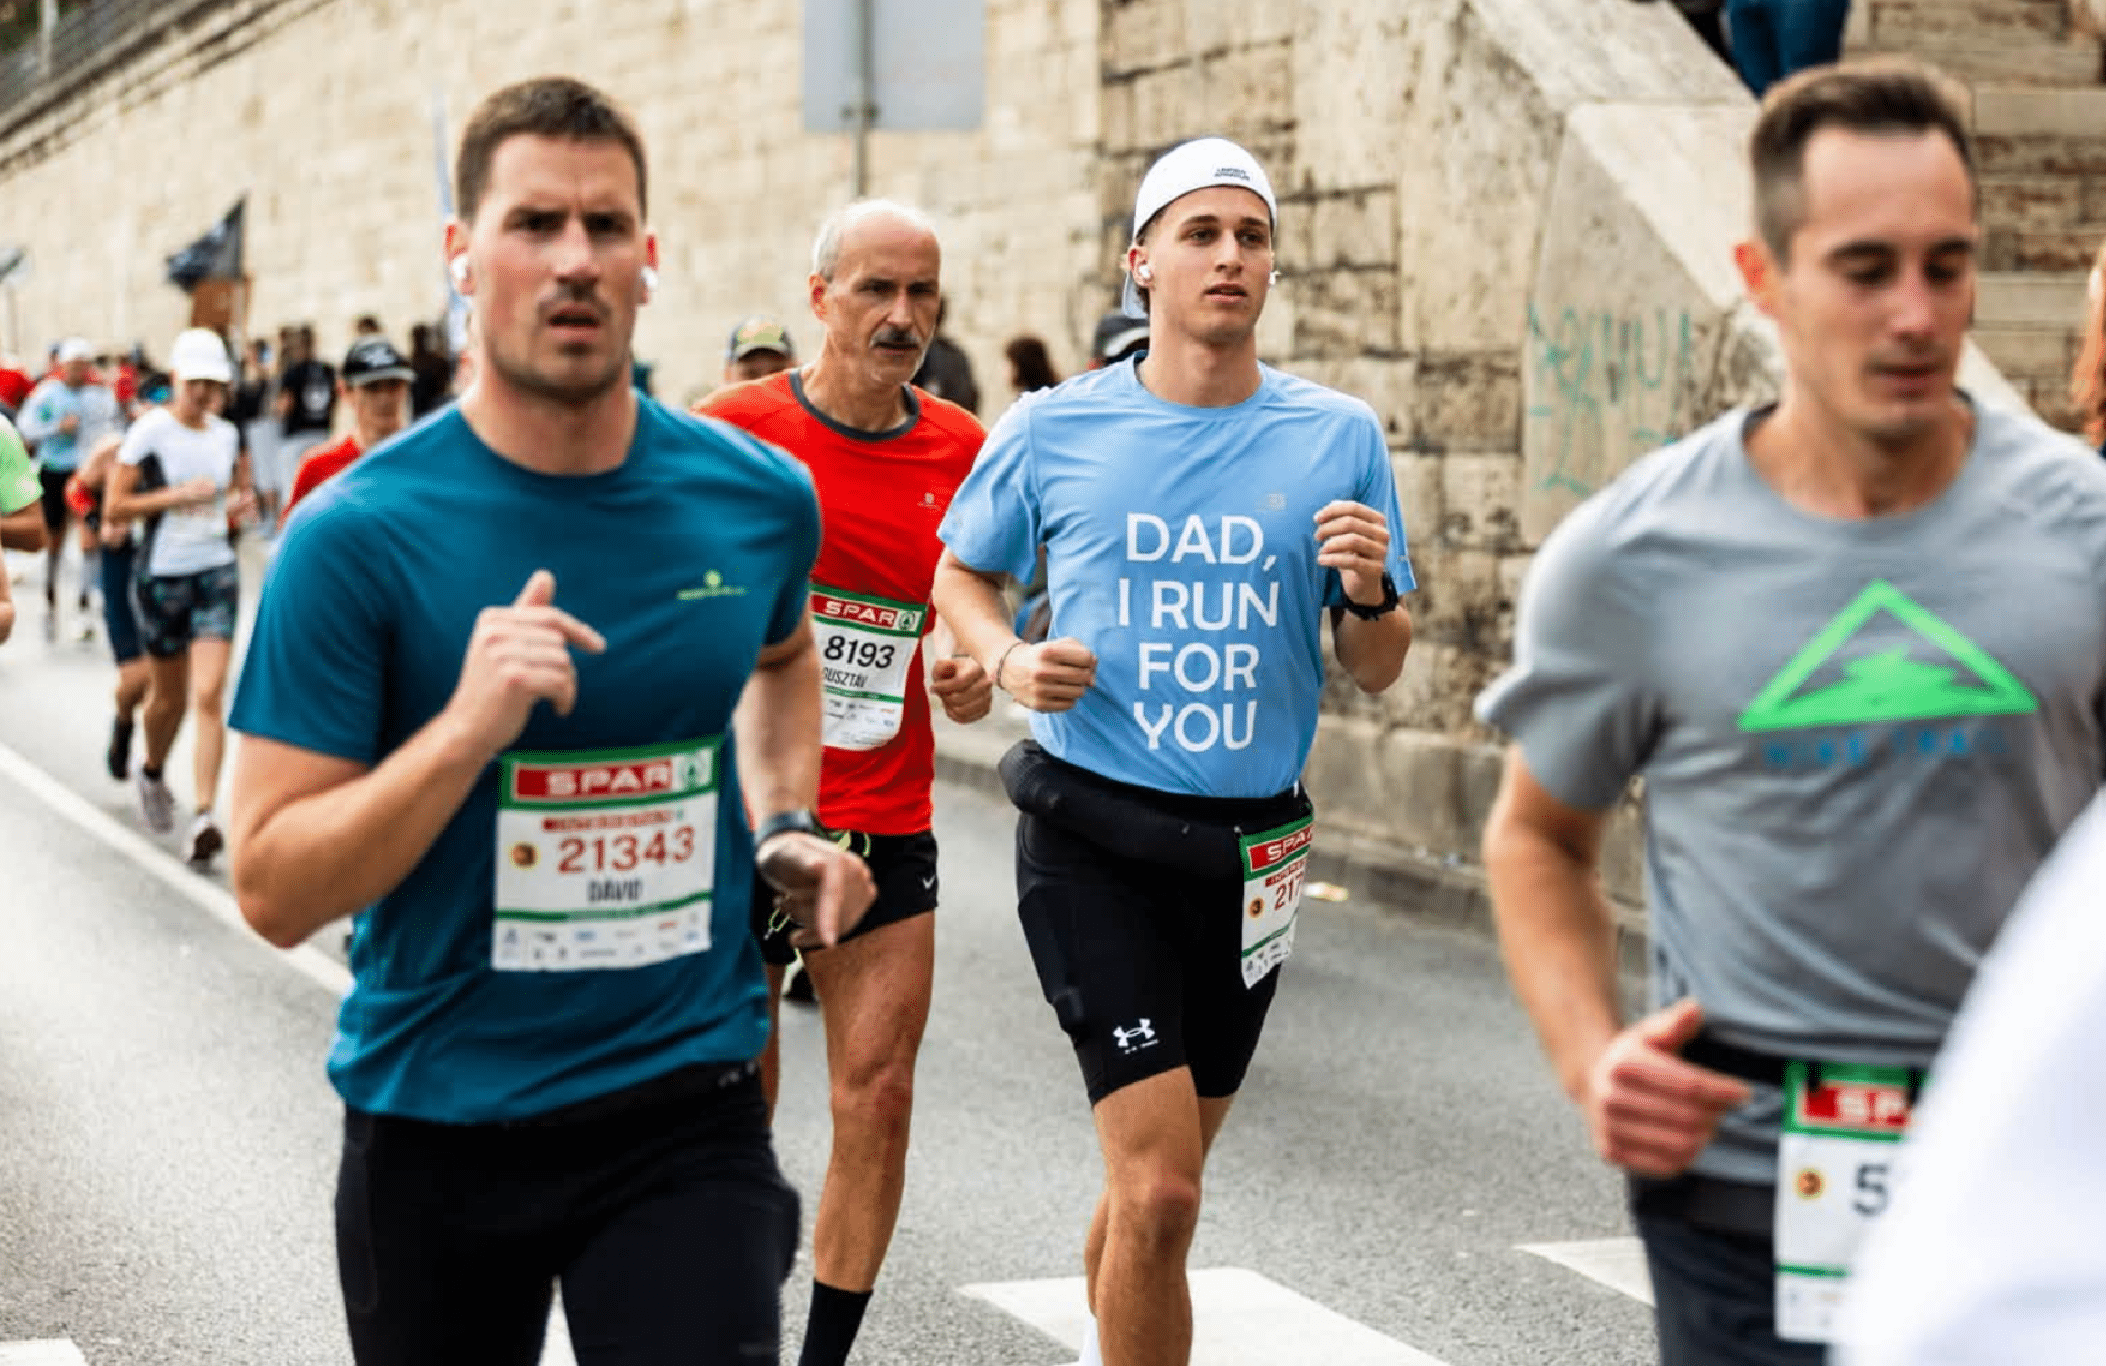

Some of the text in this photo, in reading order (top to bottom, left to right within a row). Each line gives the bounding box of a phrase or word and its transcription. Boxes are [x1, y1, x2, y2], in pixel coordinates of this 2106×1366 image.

[1126, 512, 1277, 571] DAD,
[825, 601, 895, 625] SPAR
[1118, 578, 1280, 630] I RUN
[824, 635, 895, 668] 8193
[1138, 642, 1259, 692] FOR
[1133, 700, 1257, 752] YOU
[549, 762, 670, 796] SPAR
[558, 826, 695, 874] 21343
[1274, 870, 1305, 911] 217
[1838, 1092, 1904, 1119] SP
[1852, 1163, 1889, 1217] 5
